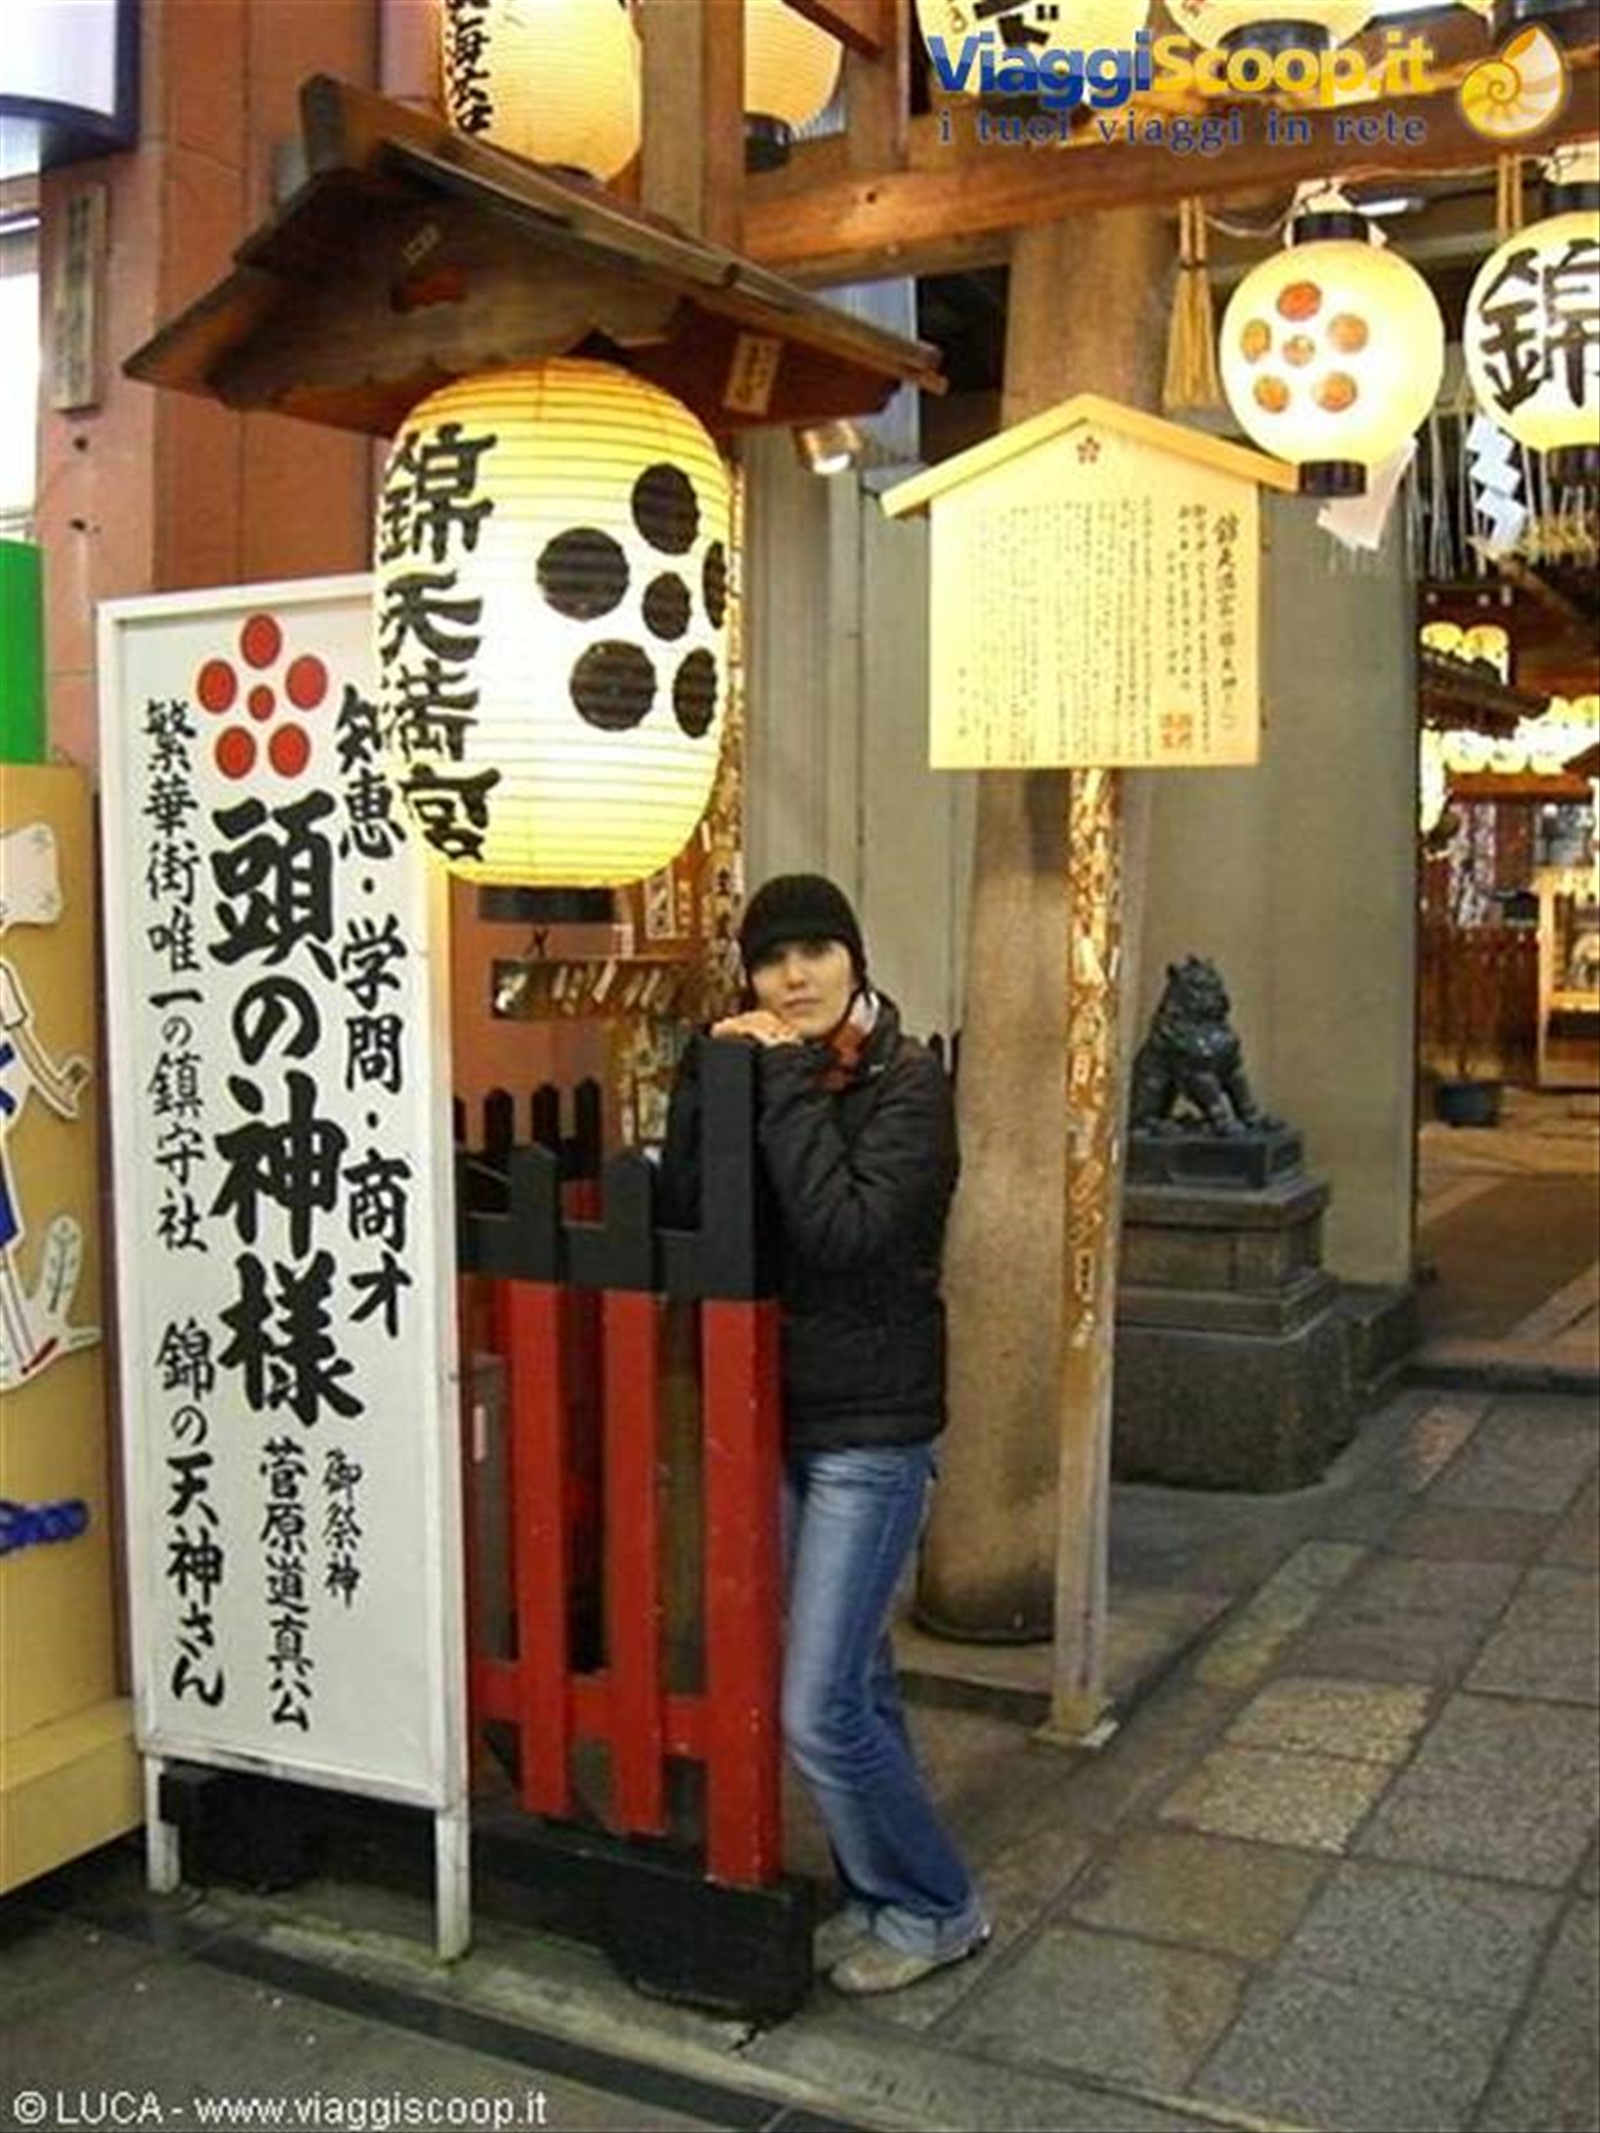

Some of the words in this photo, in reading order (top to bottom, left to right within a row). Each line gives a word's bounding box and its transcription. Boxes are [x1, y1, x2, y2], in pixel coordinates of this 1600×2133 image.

[1478, 239, 1600, 415] 錦
[379, 423, 500, 862] 錦天満宮
[142, 699, 209, 1253] 繁華街唯一の鎮守社
[208, 789, 364, 1427] 頭の神様
[156, 1317, 225, 1707] 錦の天神さん
[260, 1436, 314, 1732] 菅原道真公
[322, 1448, 362, 1609] 御祭神
